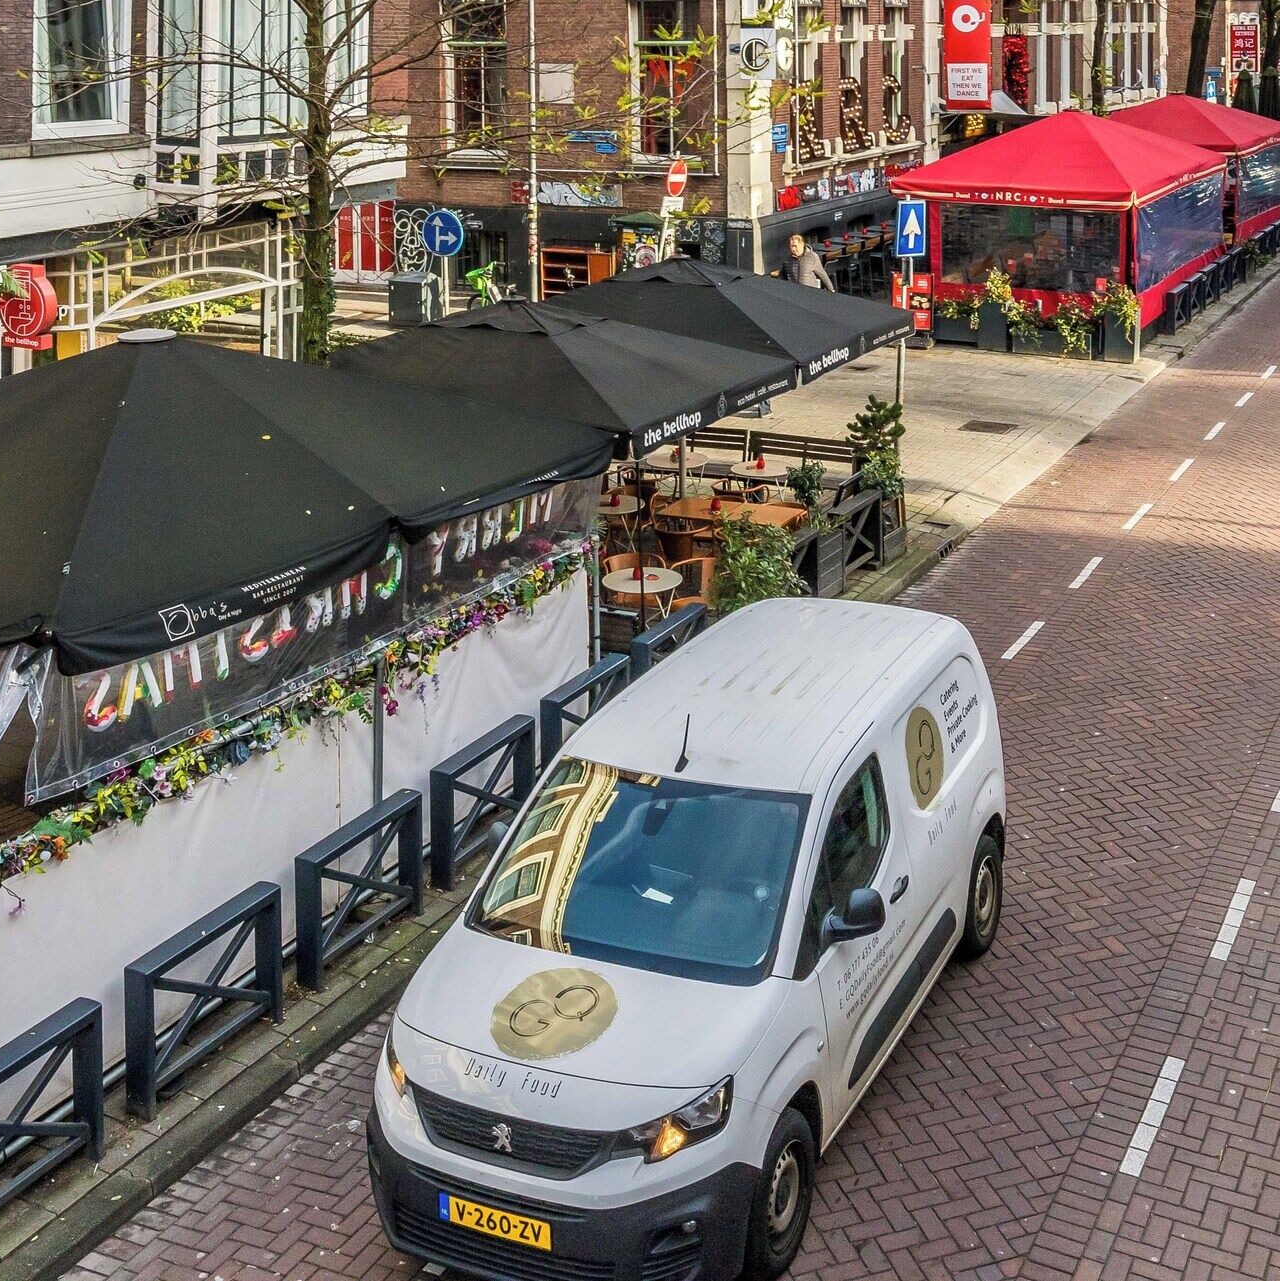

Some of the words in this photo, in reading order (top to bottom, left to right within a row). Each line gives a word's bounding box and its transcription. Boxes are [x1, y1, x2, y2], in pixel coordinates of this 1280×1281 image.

[995, 191, 1022, 202] NRC
[4, 335, 15, 344] the
[16, 337, 39, 348] bellhop
[808, 359, 822, 376] the
[822, 346, 850, 368] bellhop
[643, 427, 663, 448] the
[663, 410, 702, 439] bellhop
[240, 565, 307, 593] MEDITERRANEAN
[252, 575, 304, 599] BAR-RESTAURANT
[262, 593, 282, 604] SINCE
[282, 587, 297, 598] 2007
[939, 678, 959, 706] Catering
[943, 699, 959, 722] Events
[946, 715, 962, 738] Private
[961, 694, 979, 718] Cooking
[950, 742, 956, 754] &
[954, 728, 967, 749] More
[843, 971, 852, 984] 06
[463, 1057, 508, 1088] Daily
[520, 1071, 563, 1099] Food
[441, 1208, 449, 1216] NL
[455, 1201, 542, 1243] V-260-ZV
